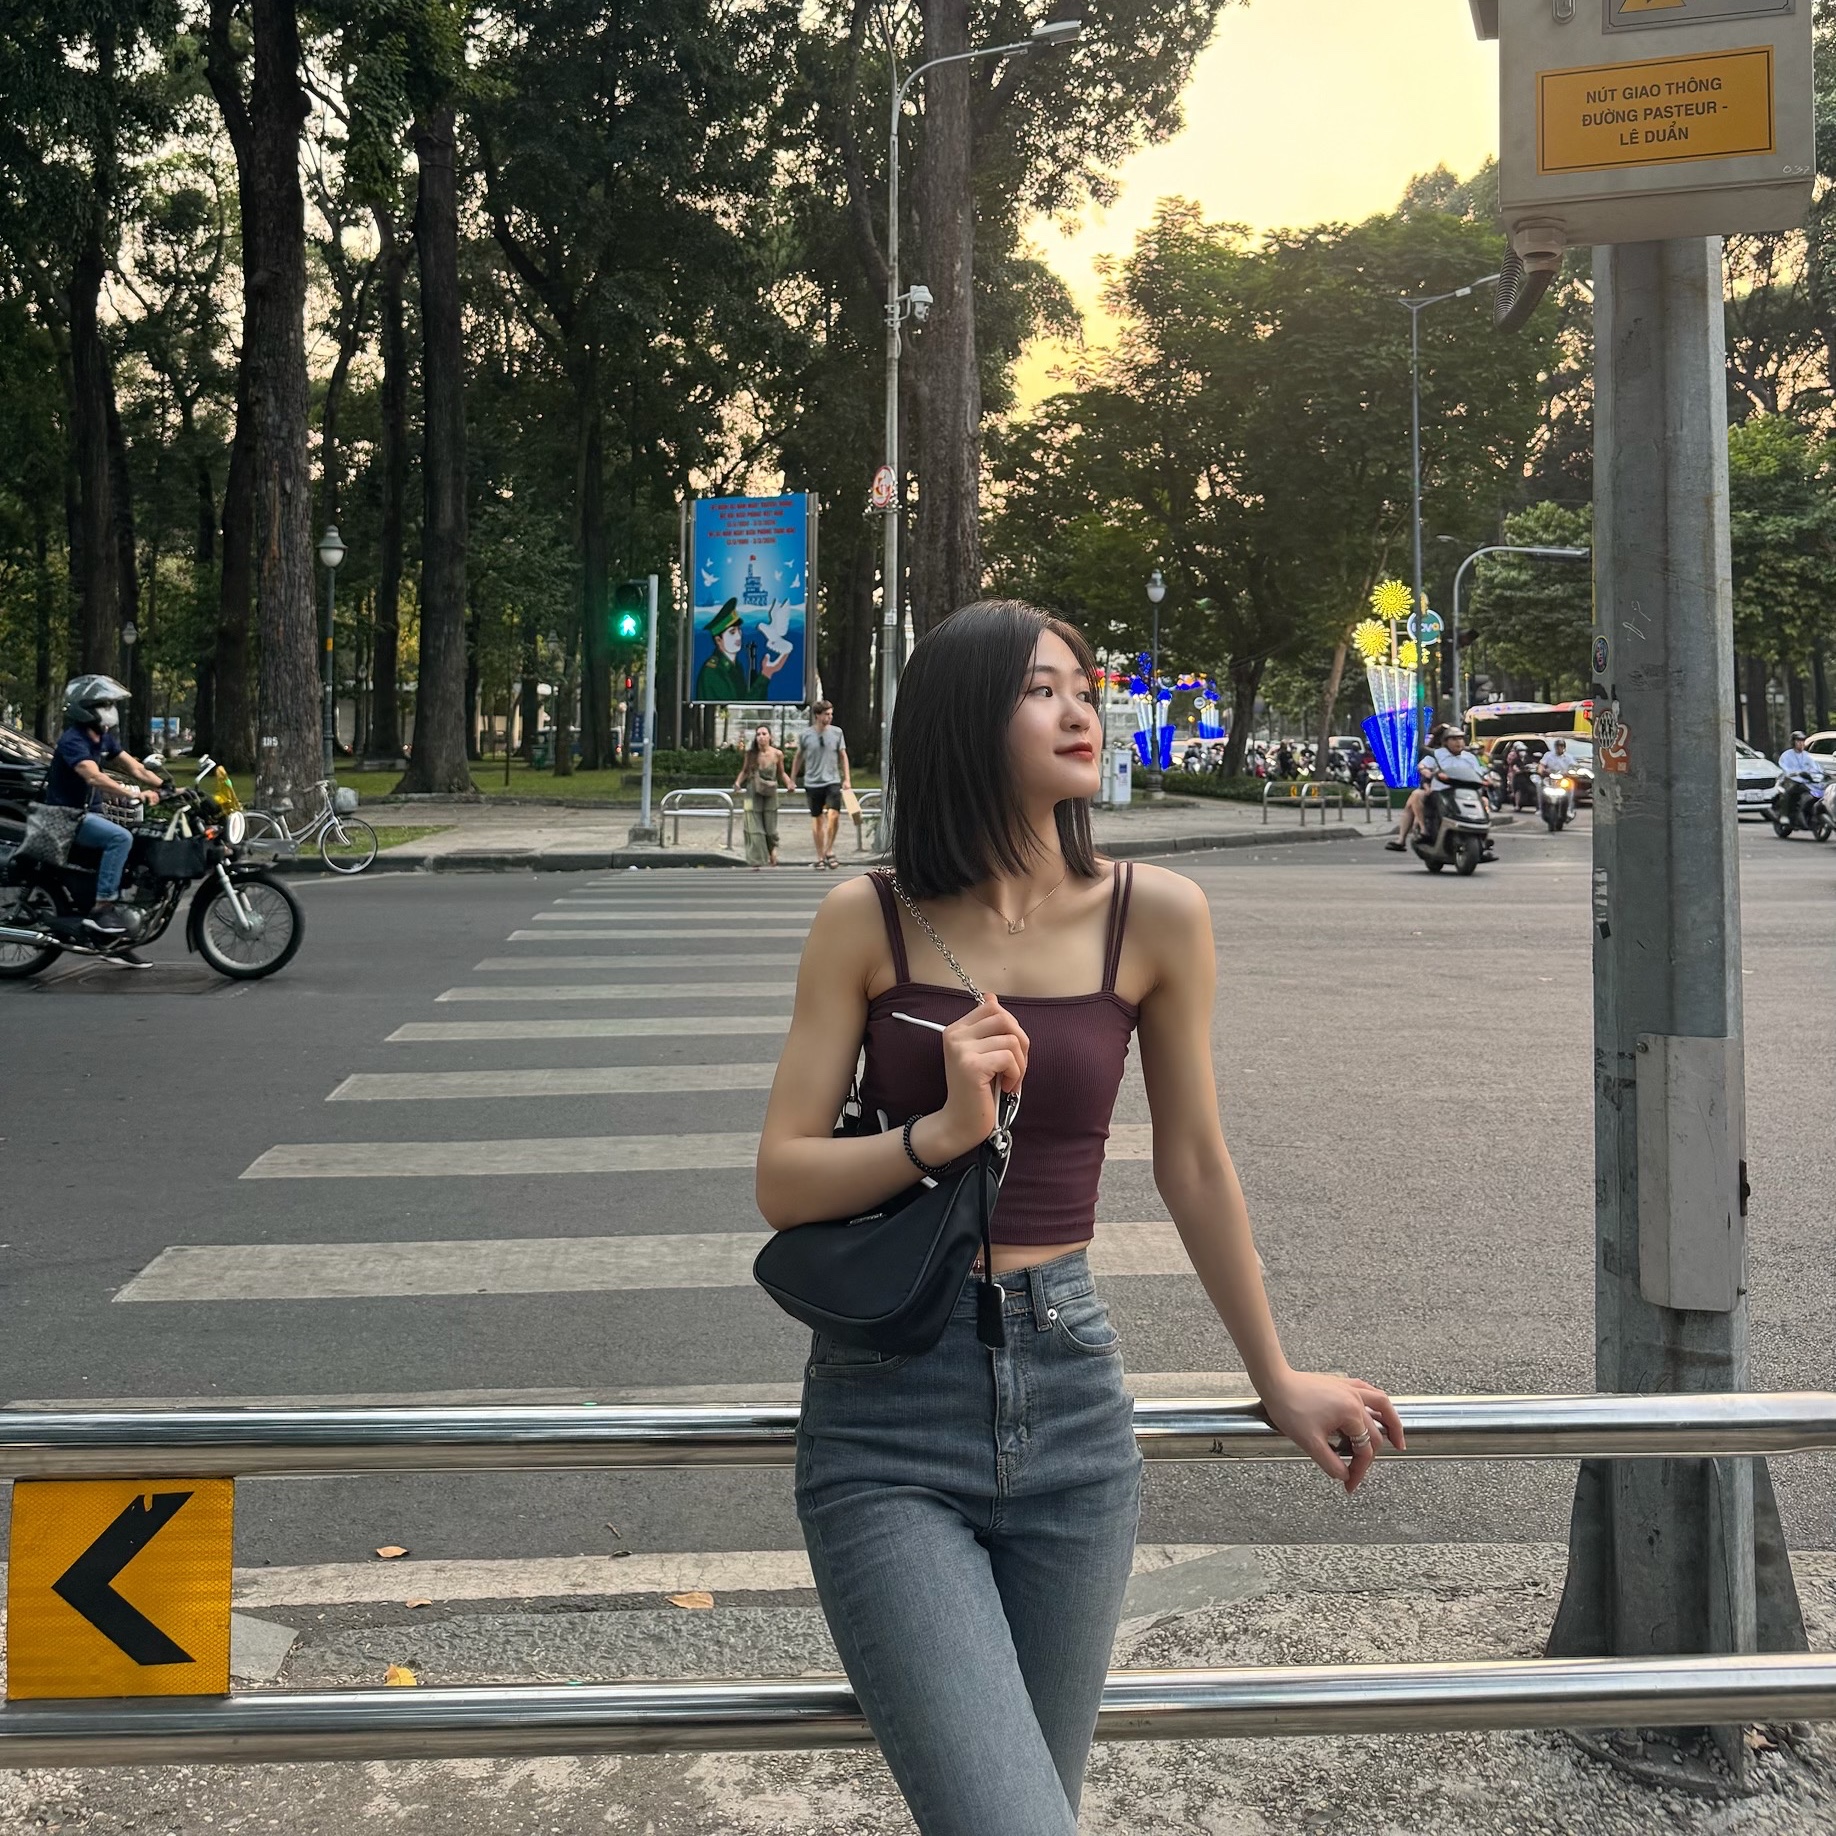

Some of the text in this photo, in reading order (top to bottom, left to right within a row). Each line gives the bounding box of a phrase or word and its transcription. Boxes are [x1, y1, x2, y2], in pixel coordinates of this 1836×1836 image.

[1586, 76, 1722, 104] NÚT GIAO THÔNG
[1582, 108, 1638, 127] ĐƯỜNG
[1643, 101, 1717, 121] PASTEUR
[1619, 121, 1689, 146] LÊ DUẨN
